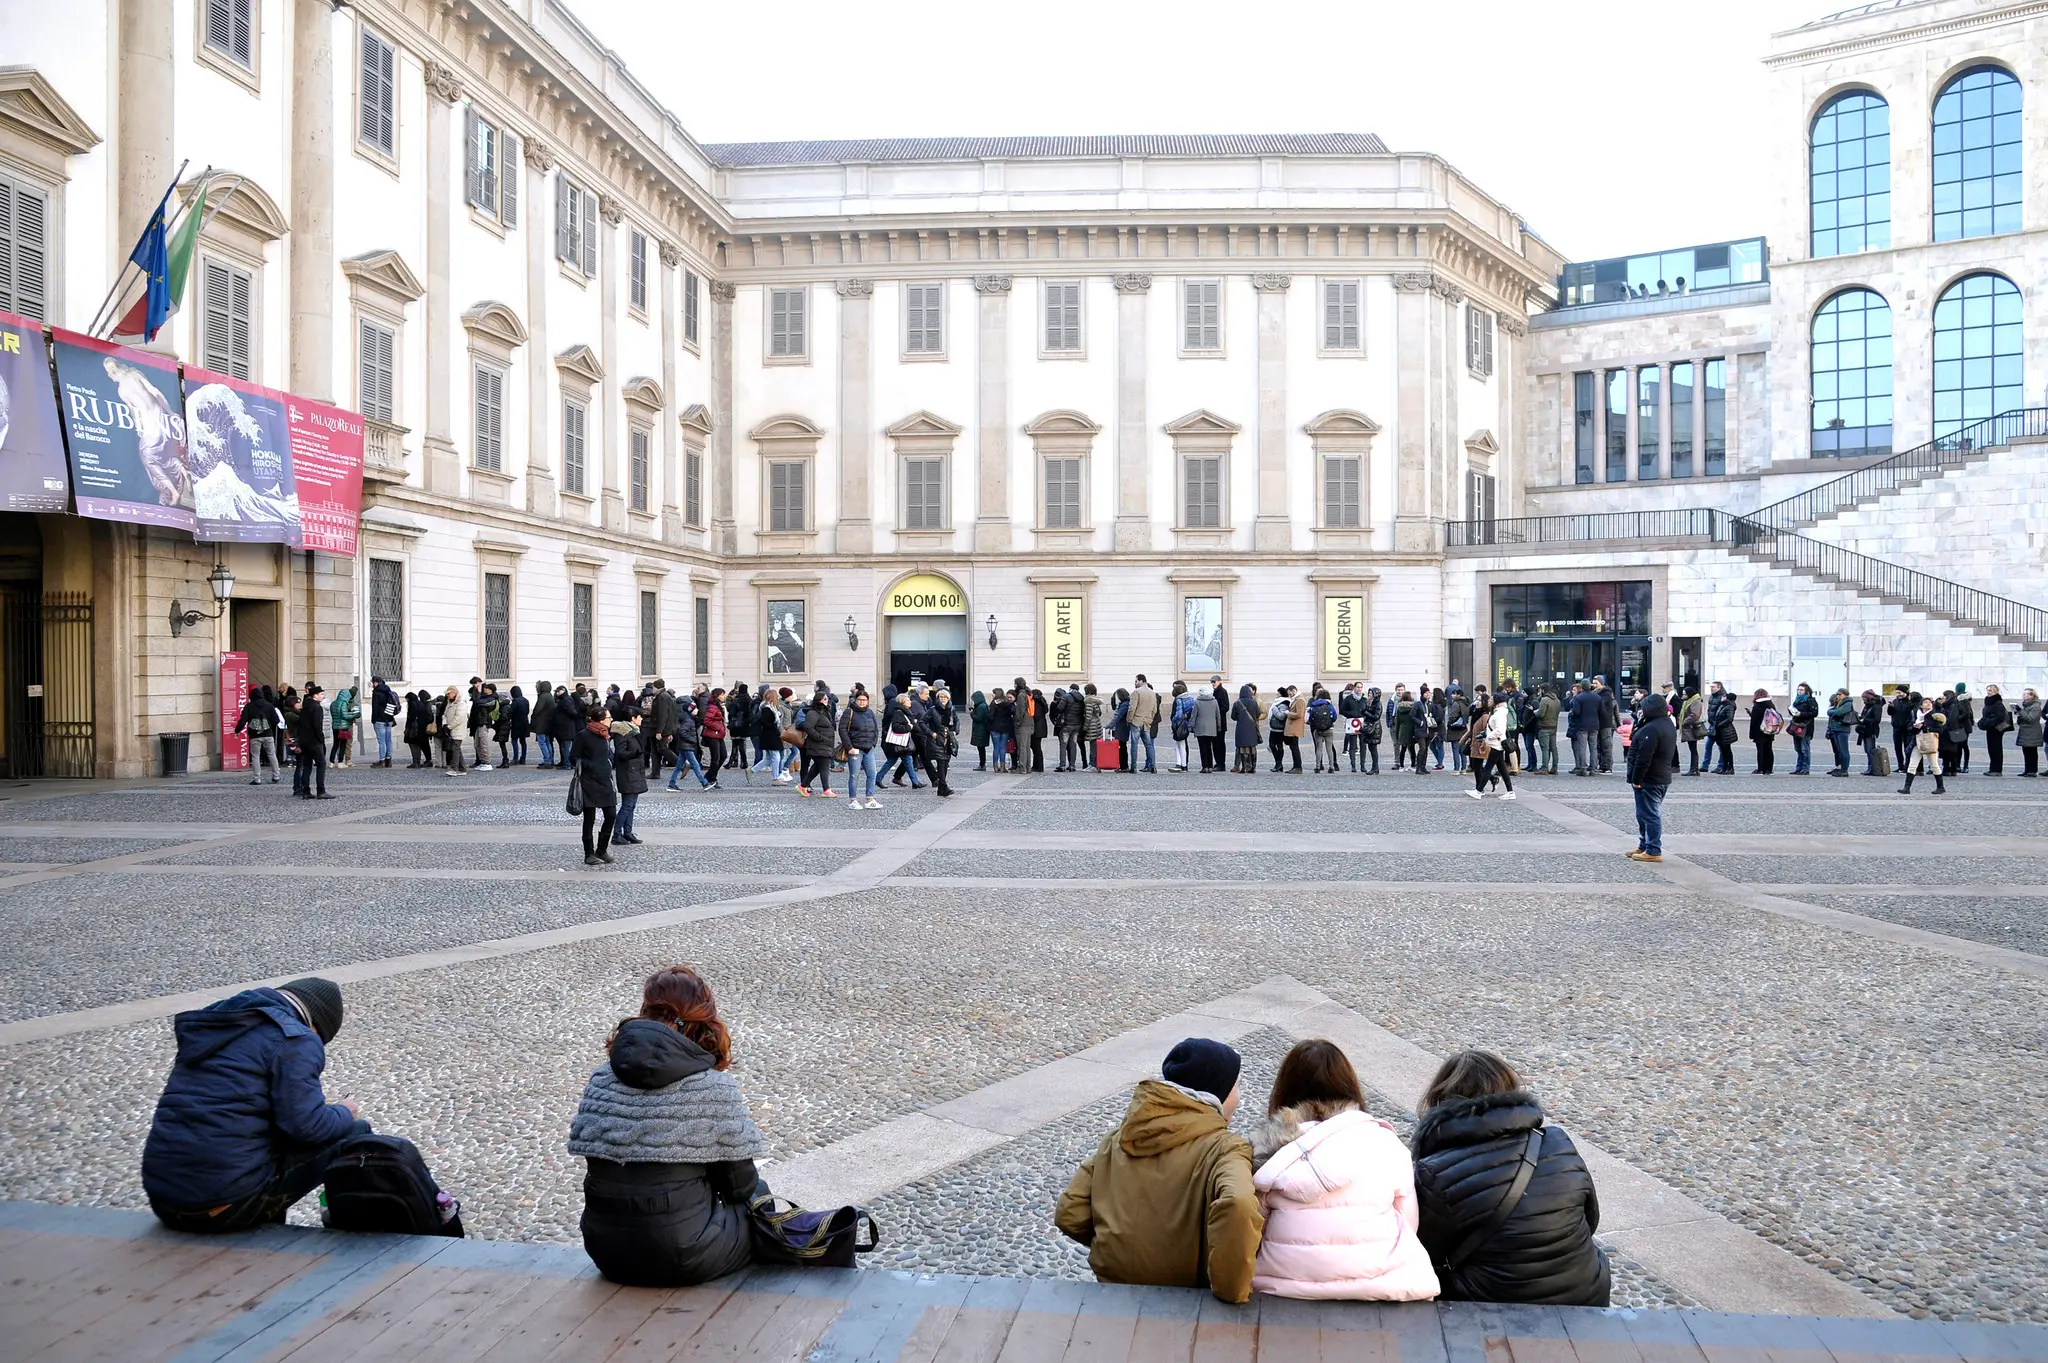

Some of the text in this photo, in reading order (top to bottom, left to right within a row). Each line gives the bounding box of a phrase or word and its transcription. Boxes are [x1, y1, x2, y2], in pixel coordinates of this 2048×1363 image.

[85, 433, 111, 444] Barocco
[894, 594, 960, 608] BOOM 60!
[1057, 601, 1071, 669] ERA ARTE
[1337, 600, 1351, 668] MODERNA
